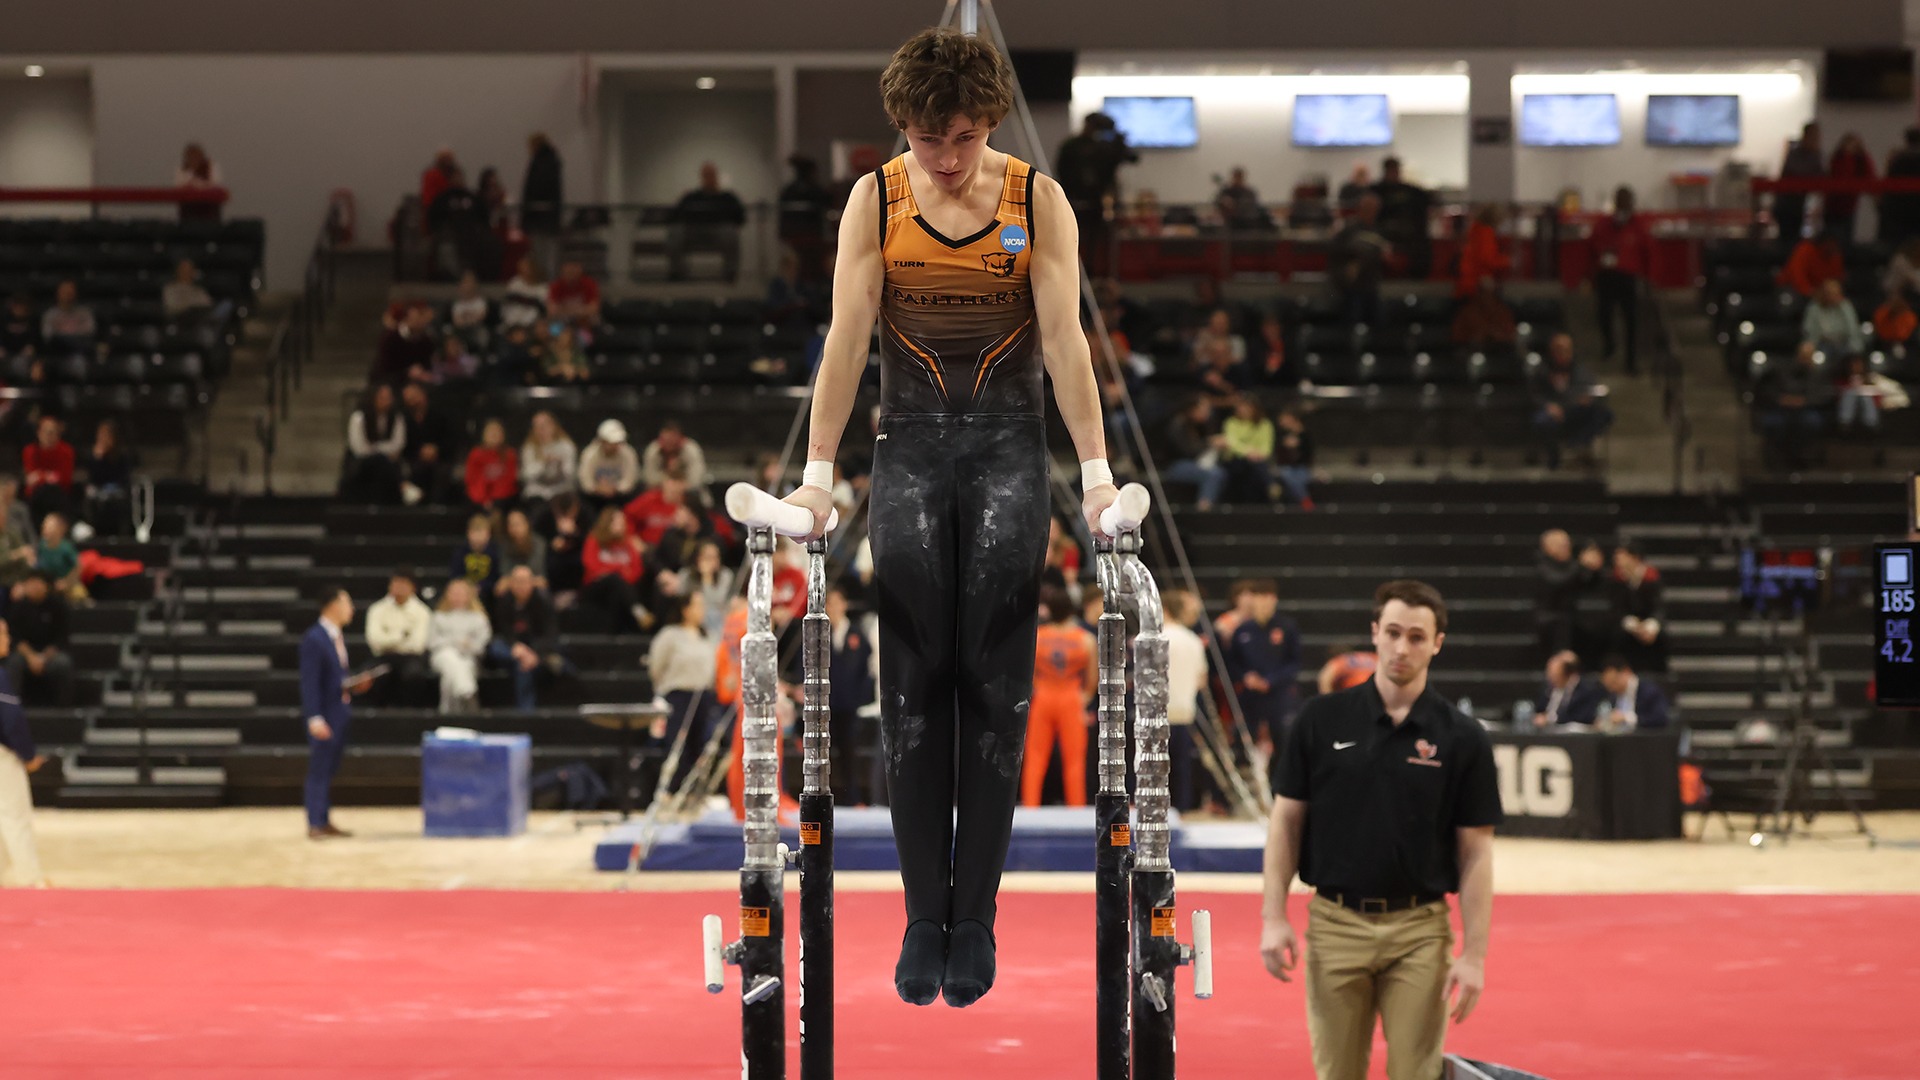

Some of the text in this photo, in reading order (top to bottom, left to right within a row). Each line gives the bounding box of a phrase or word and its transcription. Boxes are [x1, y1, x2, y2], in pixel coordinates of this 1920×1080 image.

[1004, 237, 1026, 247] NCAA
[893, 260, 925, 268] TURN
[892, 288, 1022, 306] PANTHERS
[1880, 589, 1916, 613] 185
[1885, 618, 1910, 635] Diff
[1880, 638, 1914, 663] 4.2
